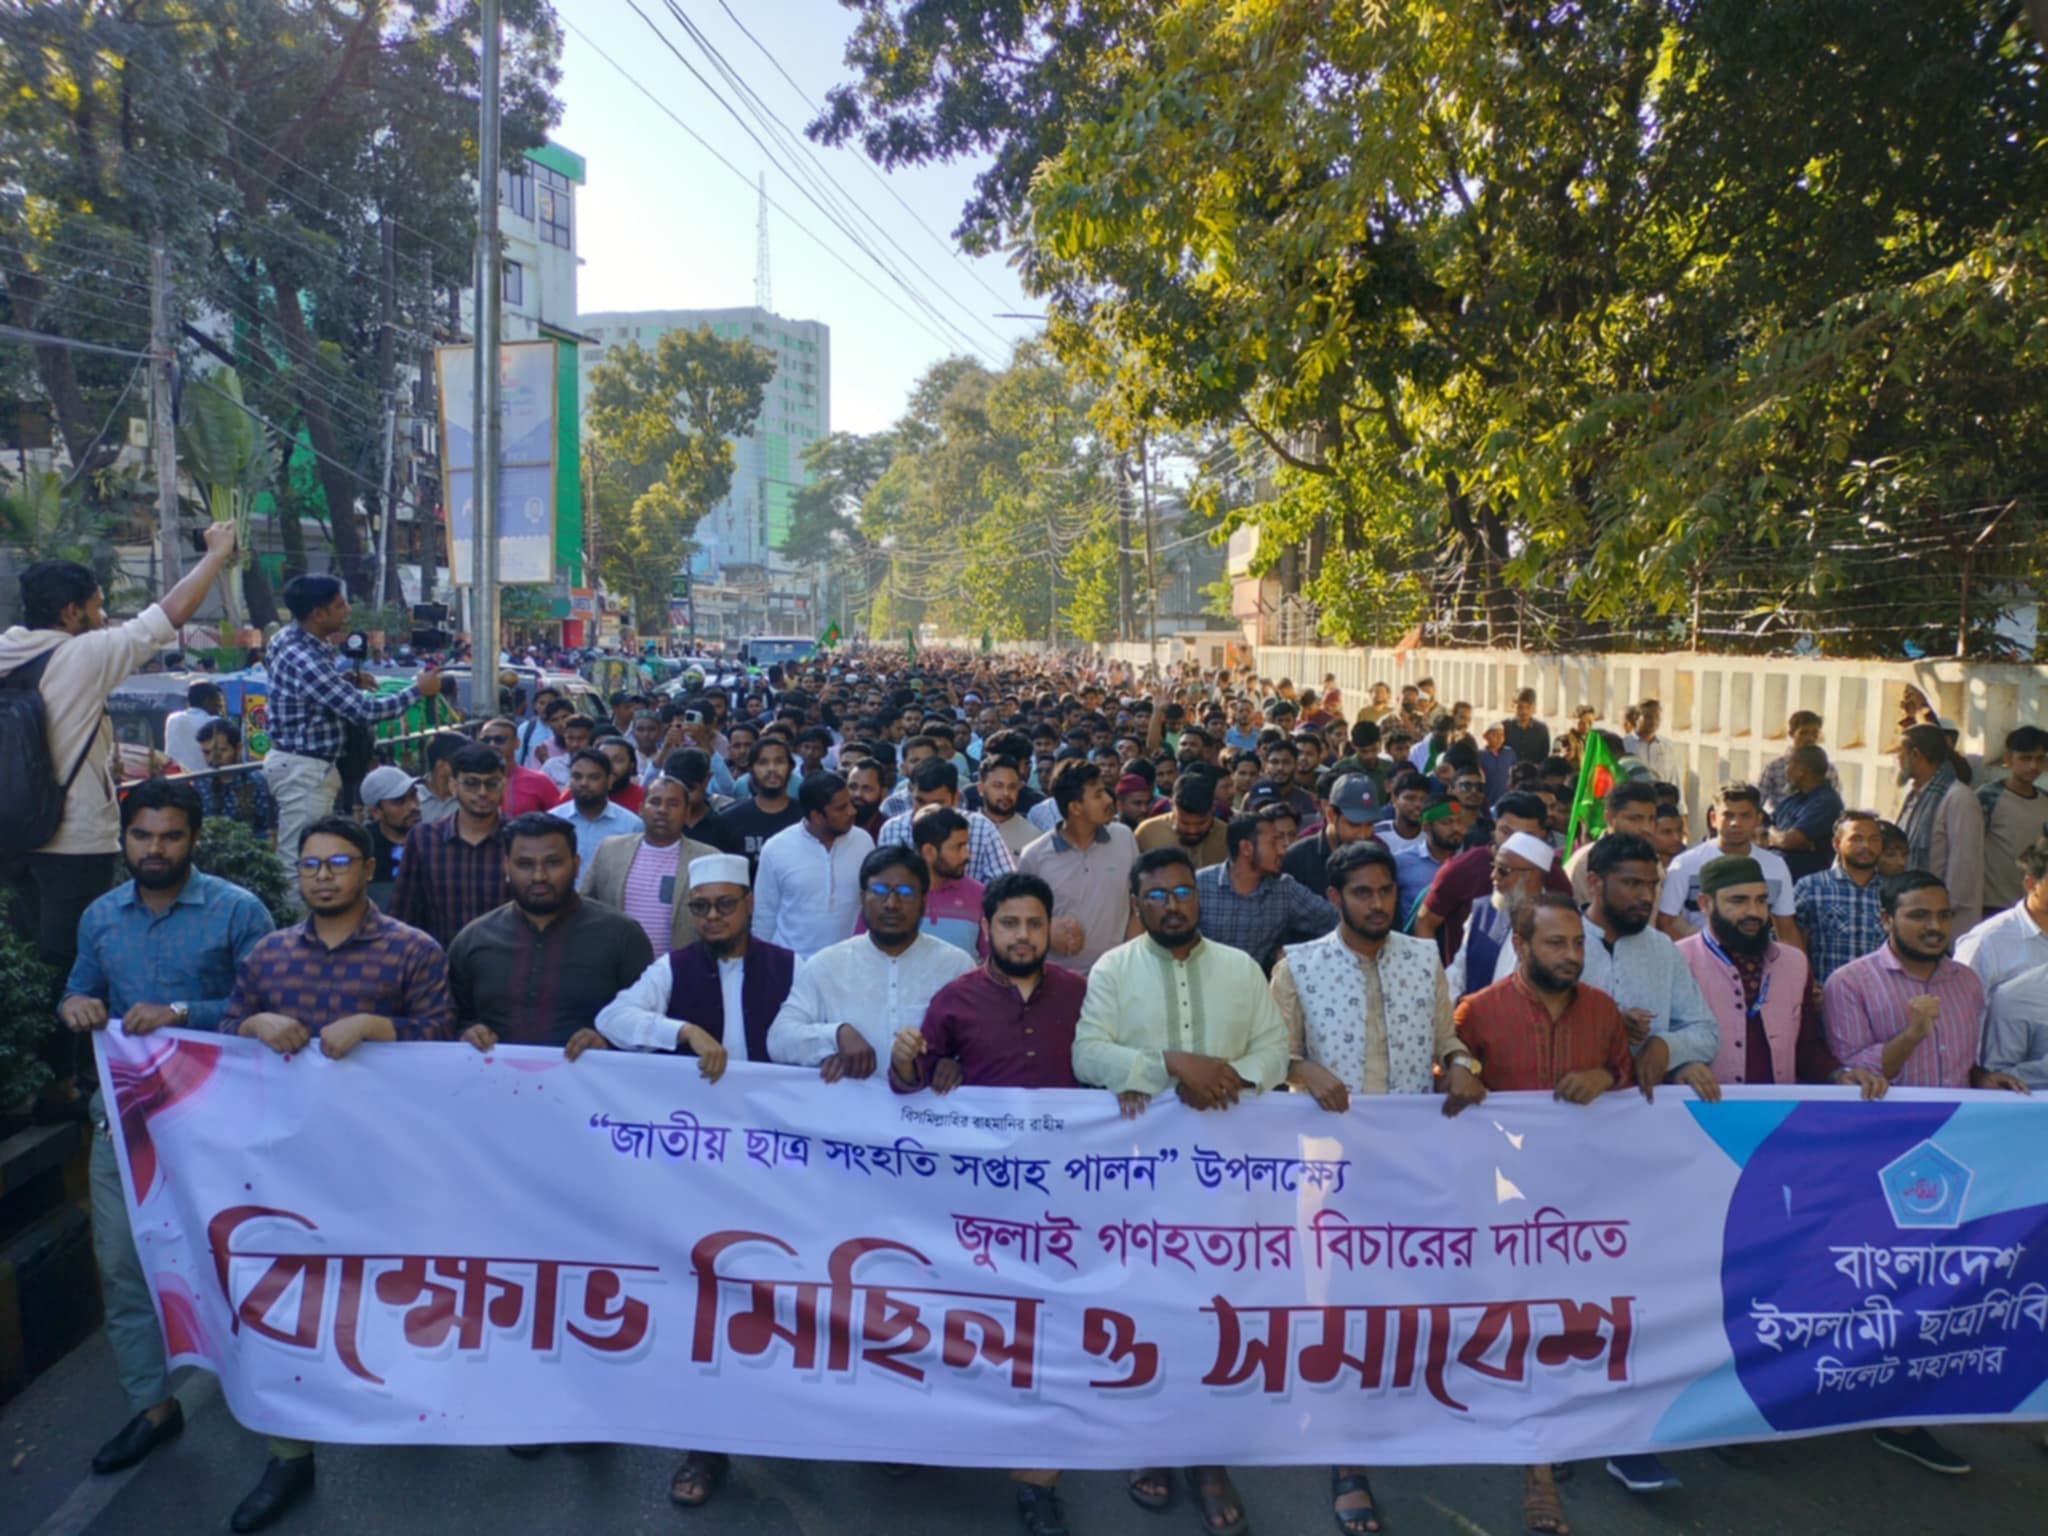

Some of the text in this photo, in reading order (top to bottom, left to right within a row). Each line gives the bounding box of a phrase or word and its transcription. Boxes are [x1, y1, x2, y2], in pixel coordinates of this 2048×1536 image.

[901, 1105, 969, 1127] বিসমিল্লাহির
[1029, 1113, 1065, 1131] রাহীম
[743, 1128, 811, 1168] ছাত্র
[823, 1137, 938, 1178] সংহতি
[952, 1153, 1050, 1195] সপ্তাহ
[1064, 1148, 1179, 1192] পালন”
[951, 1206, 1630, 1272] জুলাই গণহত্যার বিচারের দাবিতে
[1829, 1241, 2026, 1290] বাংলাদেশ
[690, 1229, 1045, 1389] মিছিল
[1082, 1307, 1158, 1389] ও
[1199, 1295, 1636, 1412] সমাবেশ
[1749, 1281, 2048, 1352] ইসলামী ছাত্রশিবি
[1815, 1345, 2006, 1395] সিলেট মহানগর
